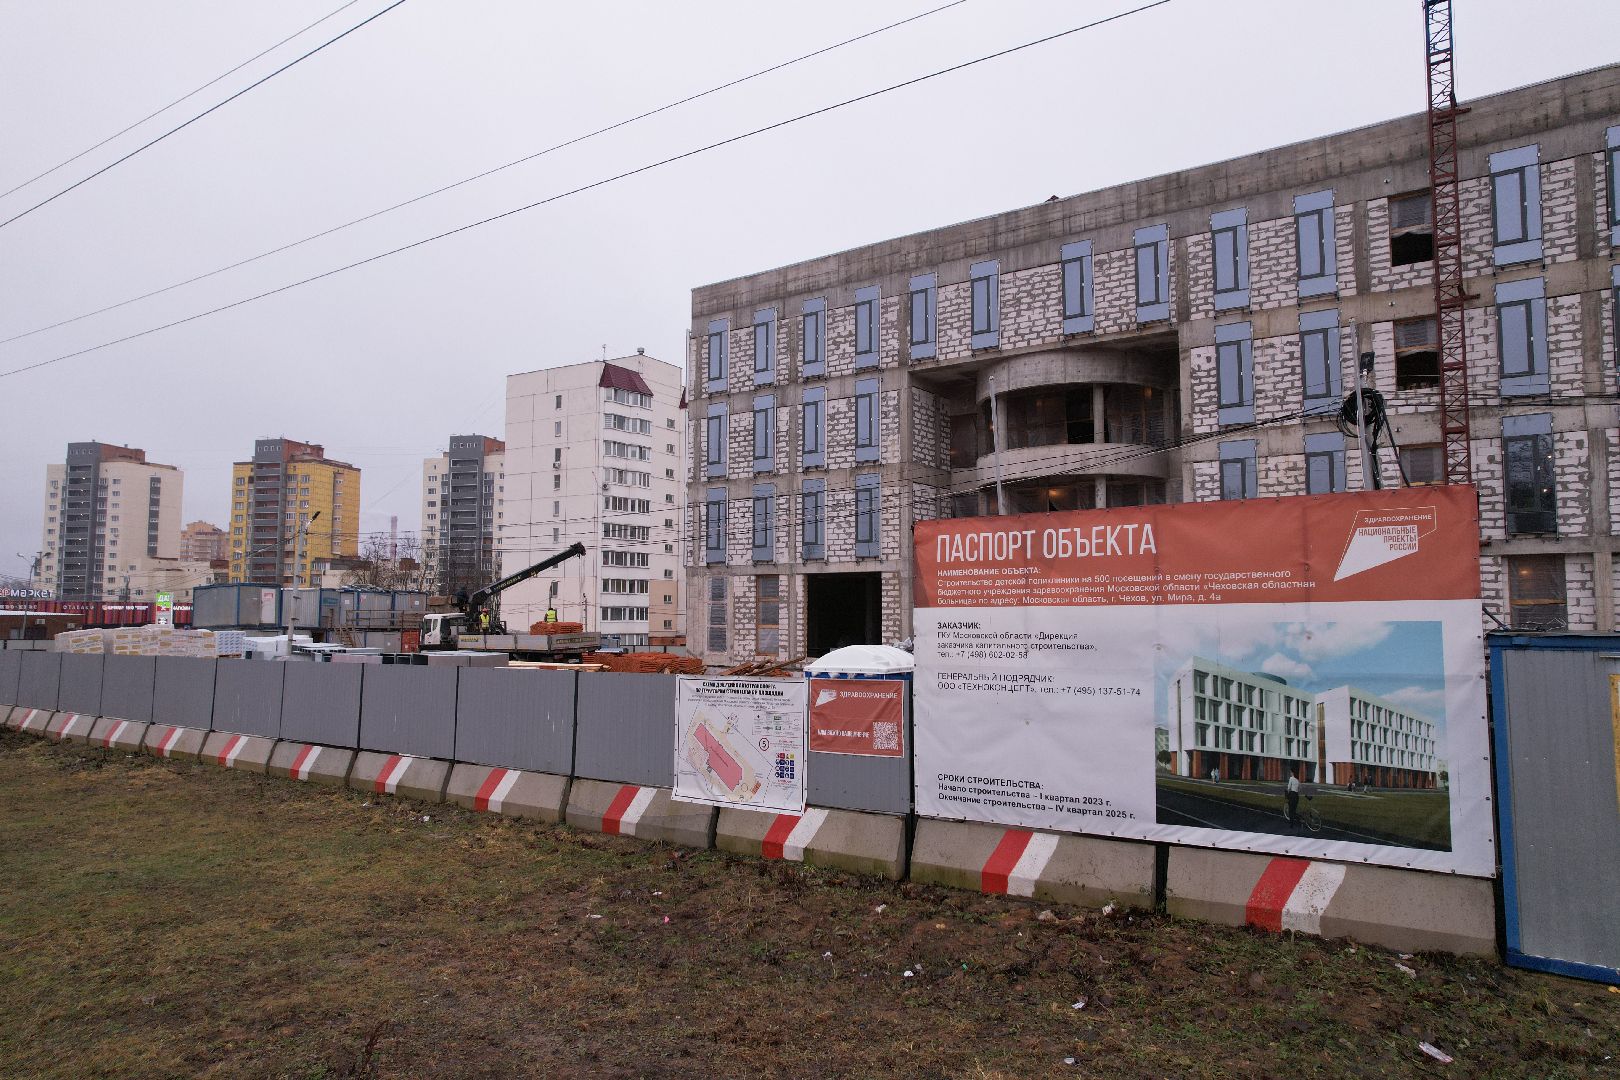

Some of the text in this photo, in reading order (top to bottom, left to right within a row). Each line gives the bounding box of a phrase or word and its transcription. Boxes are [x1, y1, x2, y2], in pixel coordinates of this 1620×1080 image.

[1364, 513, 1432, 524] ЗДРАВООХРАНЕНИЕ
[1358, 526, 1416, 536] НАЦИОНАЛЬНЫЕ
[936, 523, 1157, 563] ПАСПОРТ ОБЪЕКТА
[1383, 534, 1417, 543] ПРОЕКТЫ
[1389, 543, 1417, 551] РОССИИ
[937, 567, 1041, 576] НАИМЕНОВАНИЕ ОБЪЕКТА:
[937, 578, 993, 587] Строительство
[995, 577, 1026, 587] детской
[1094, 574, 1110, 583] 500
[1112, 573, 1163, 584] посещений
[1173, 572, 1202, 582] смену
[1204, 570, 1291, 581] государственного
[937, 580, 1316, 597] бюджетного учреждения здравоохранения Московской области «Чеховская областная
[979, 597, 988, 605] по
[1022, 595, 1070, 604] Московская
[1072, 594, 1109, 605] область,
[1118, 594, 1149, 604] Чехов,
[1151, 594, 1165, 604] ул.
[1167, 592, 1195, 603] Мира,
[1198, 594, 1207, 603] д.
[1209, 593, 1221, 601] 4а
[937, 621, 981, 630] ЗАКАЗЧИК:
[937, 631, 1078, 641] ГКУ Московской области «Дирекция
[975, 642, 1028, 651] капитального
[955, 651, 965, 659] +7
[937, 672, 1055, 684] ГЕНЕРАЛЬНЫЙ ПОДРЯДЧИК:
[937, 681, 956, 690] ООО
[1060, 686, 1072, 694] +7
[1073, 686, 1096, 696] (495)
[1098, 687, 1141, 696] 137-51-74
[839, 691, 898, 699] ЗДРАВООХРАНЕНИЕ
[937, 773, 1044, 790] СРОКИ СТРОИТЕЛЬСТВА:
[938, 783, 967, 793] Начало
[969, 786, 1030, 799] строительства
[1044, 794, 1080, 804] квартал
[1082, 796, 1104, 806] 2023
[938, 792, 981, 804] Окончание
[983, 799, 1046, 811] строительства
[1055, 804, 1064, 813] IV
[1066, 806, 1103, 817] квартал
[1105, 809, 1127, 819] 2025
